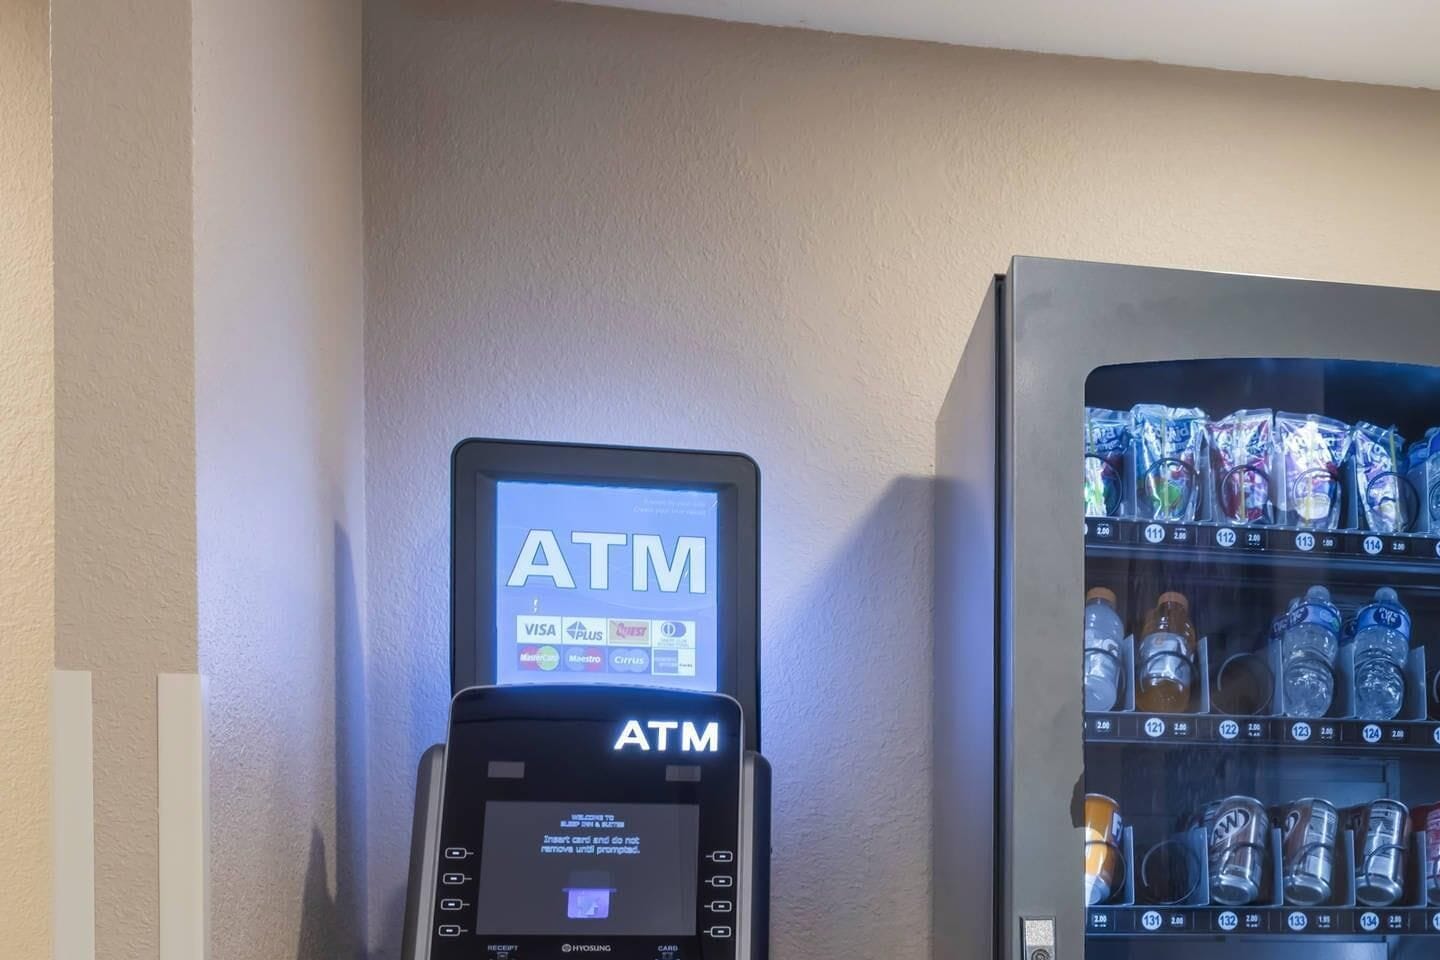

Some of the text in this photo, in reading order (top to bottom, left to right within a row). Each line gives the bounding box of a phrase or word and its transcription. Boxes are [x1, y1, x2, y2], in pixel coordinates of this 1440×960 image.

[1147, 528, 1164, 539] 111
[1218, 531, 1235, 543] 112
[1297, 536, 1314, 547] 113
[1364, 540, 1381, 551] 114
[506, 528, 707, 594] ATM
[525, 624, 556, 636] VISA
[576, 631, 603, 641] PLUS
[569, 655, 600, 663] Maestro
[614, 656, 645, 665] Cirrus
[1146, 722, 1163, 733] 121
[1221, 724, 1238, 735] 122
[1293, 726, 1309, 737] 123
[614, 720, 719, 752] ATM
[1364, 728, 1380, 739] 124
[544, 835, 570, 844] Insert
[572, 836, 591, 844] card
[593, 836, 610, 844] and
[612, 836, 623, 844] do
[541, 845, 640, 855] remove until prompted.
[1143, 915, 1161, 926] 131
[1219, 915, 1237, 926] 132
[1289, 915, 1306, 926] 133
[1362, 916, 1378, 927] 134
[573, 944, 611, 952] HYOSUNG
